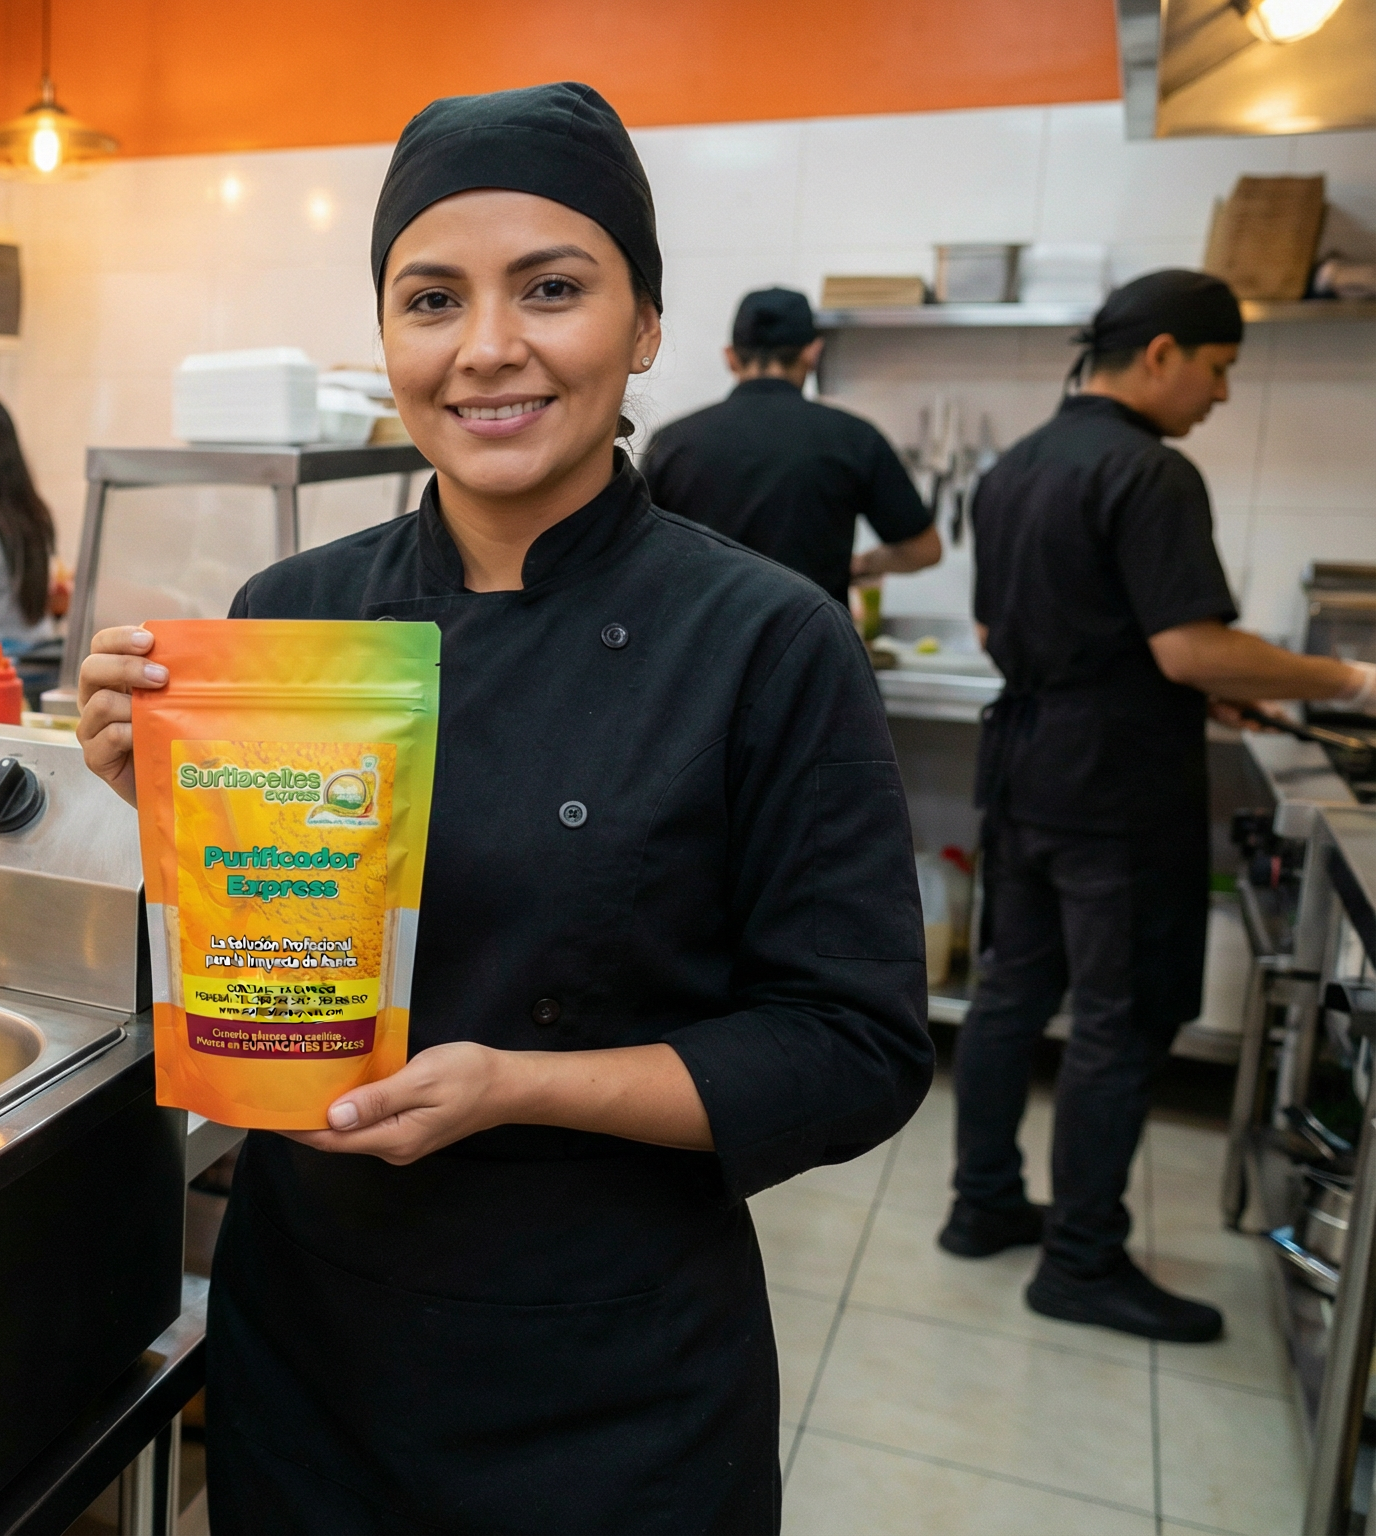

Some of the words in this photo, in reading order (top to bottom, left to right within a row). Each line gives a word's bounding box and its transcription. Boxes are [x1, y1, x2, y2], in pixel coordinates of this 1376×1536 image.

[205, 846, 360, 869] Purificador
[227, 875, 339, 902] Express
[210, 935, 226, 949] La
